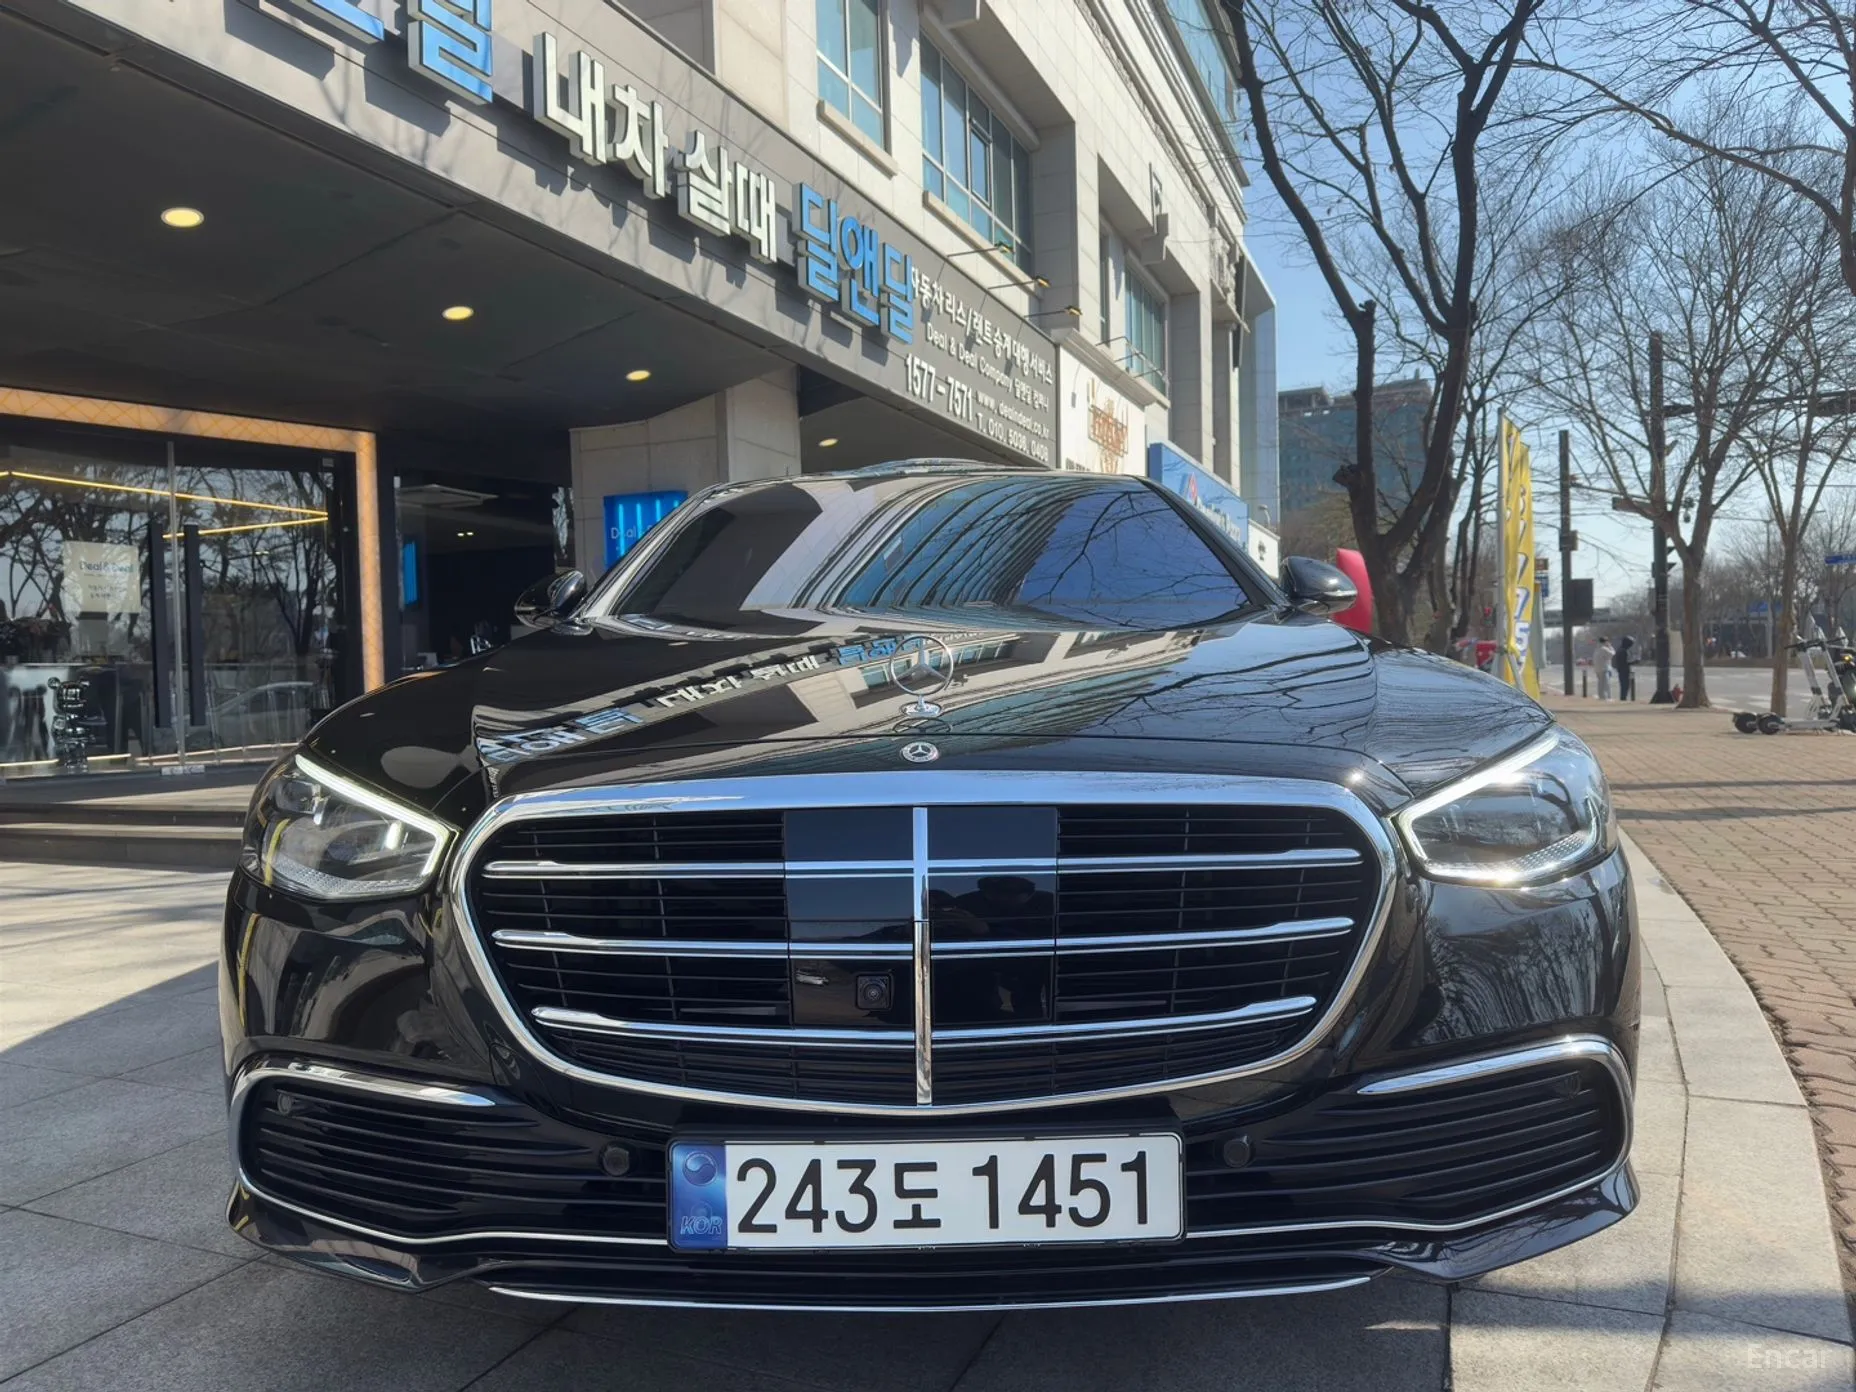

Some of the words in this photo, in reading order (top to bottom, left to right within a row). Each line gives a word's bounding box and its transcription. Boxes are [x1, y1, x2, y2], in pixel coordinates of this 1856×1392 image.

[544, 31, 668, 197] 내차
[685, 130, 777, 262] 살때
[800, 183, 913, 344] 딜앤딜
[906, 353, 973, 422] 1577-7571
[926, 322, 948, 351] Deal
[950, 336, 957, 356] &
[959, 342, 977, 368] Deal
[979, 356, 1013, 392] Company
[611, 525, 637, 539] Dal
[680, 1215, 723, 1235] KOR
[737, 1158, 942, 1234] 243도
[972, 1151, 1148, 1230] 1451
